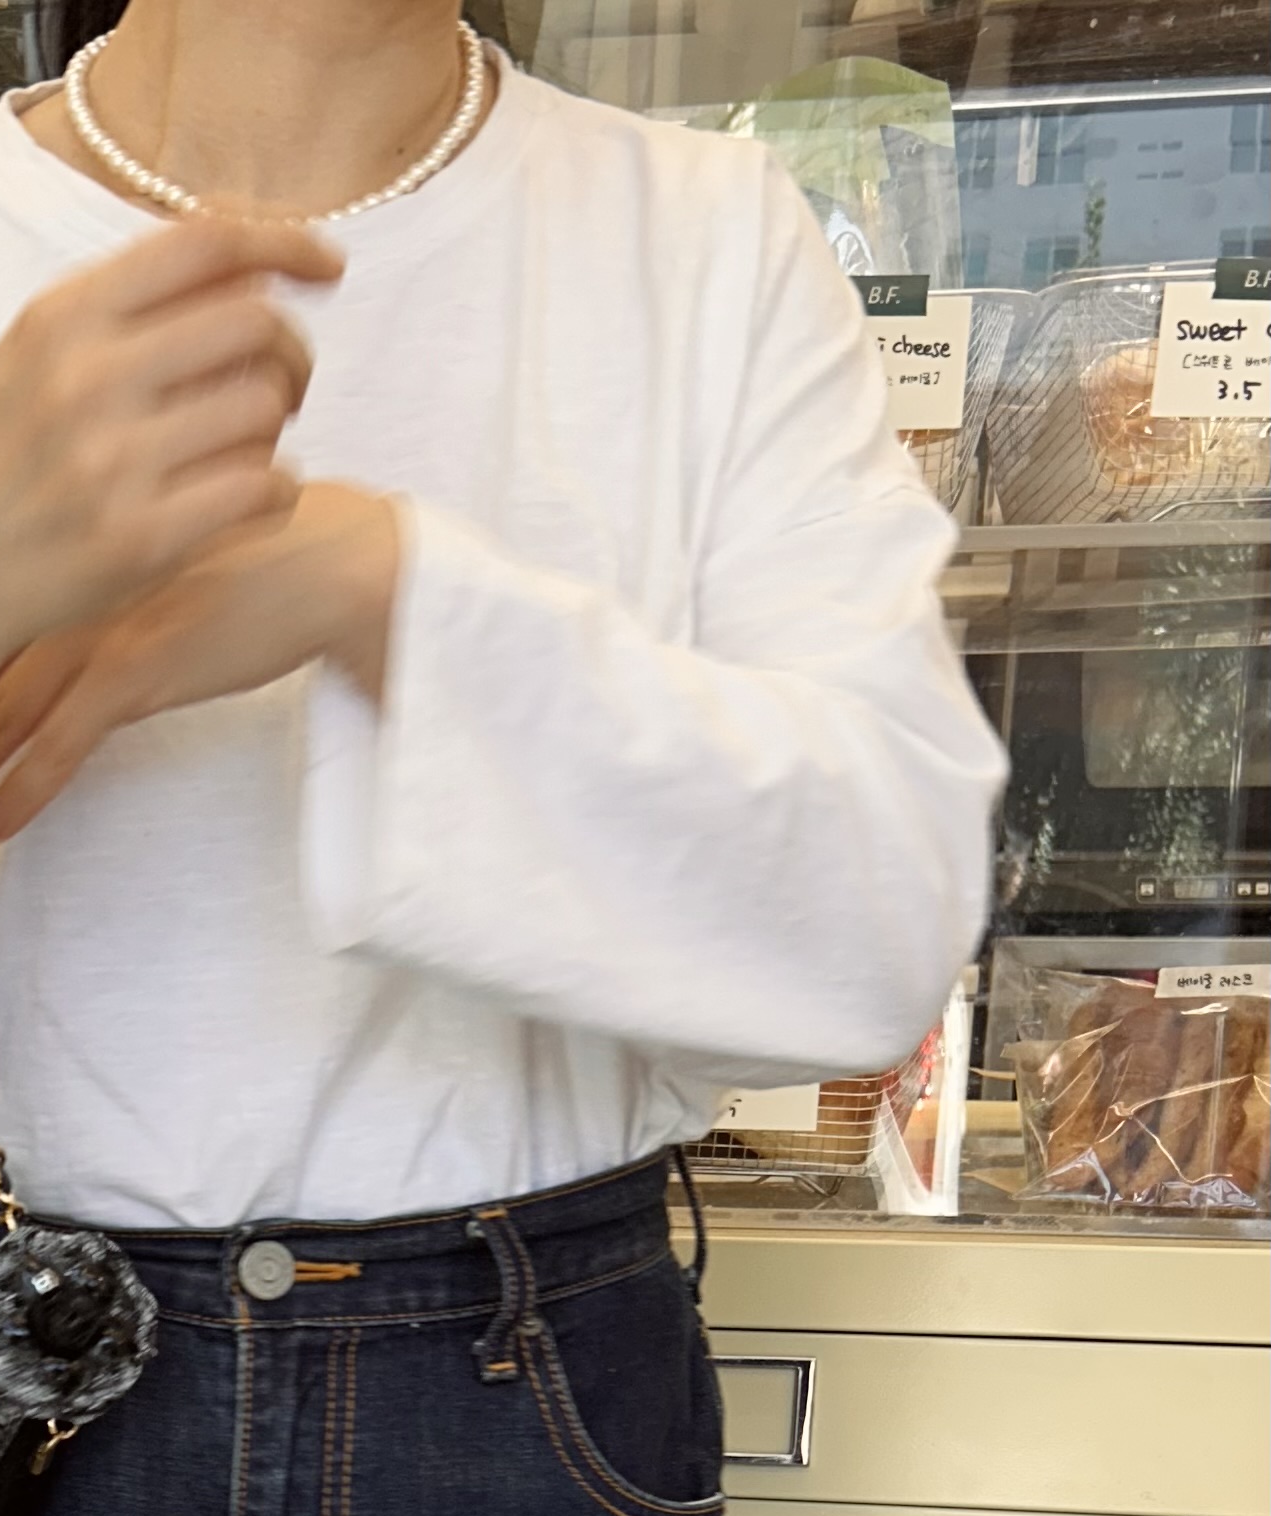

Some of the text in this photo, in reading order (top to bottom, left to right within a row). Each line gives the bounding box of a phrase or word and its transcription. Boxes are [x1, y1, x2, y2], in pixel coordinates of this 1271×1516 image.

[868, 286, 901, 305] B.F.
[1177, 318, 1248, 341] Sweet
[892, 334, 951, 358] cheese
[1218, 380, 1262, 400] 3.5
